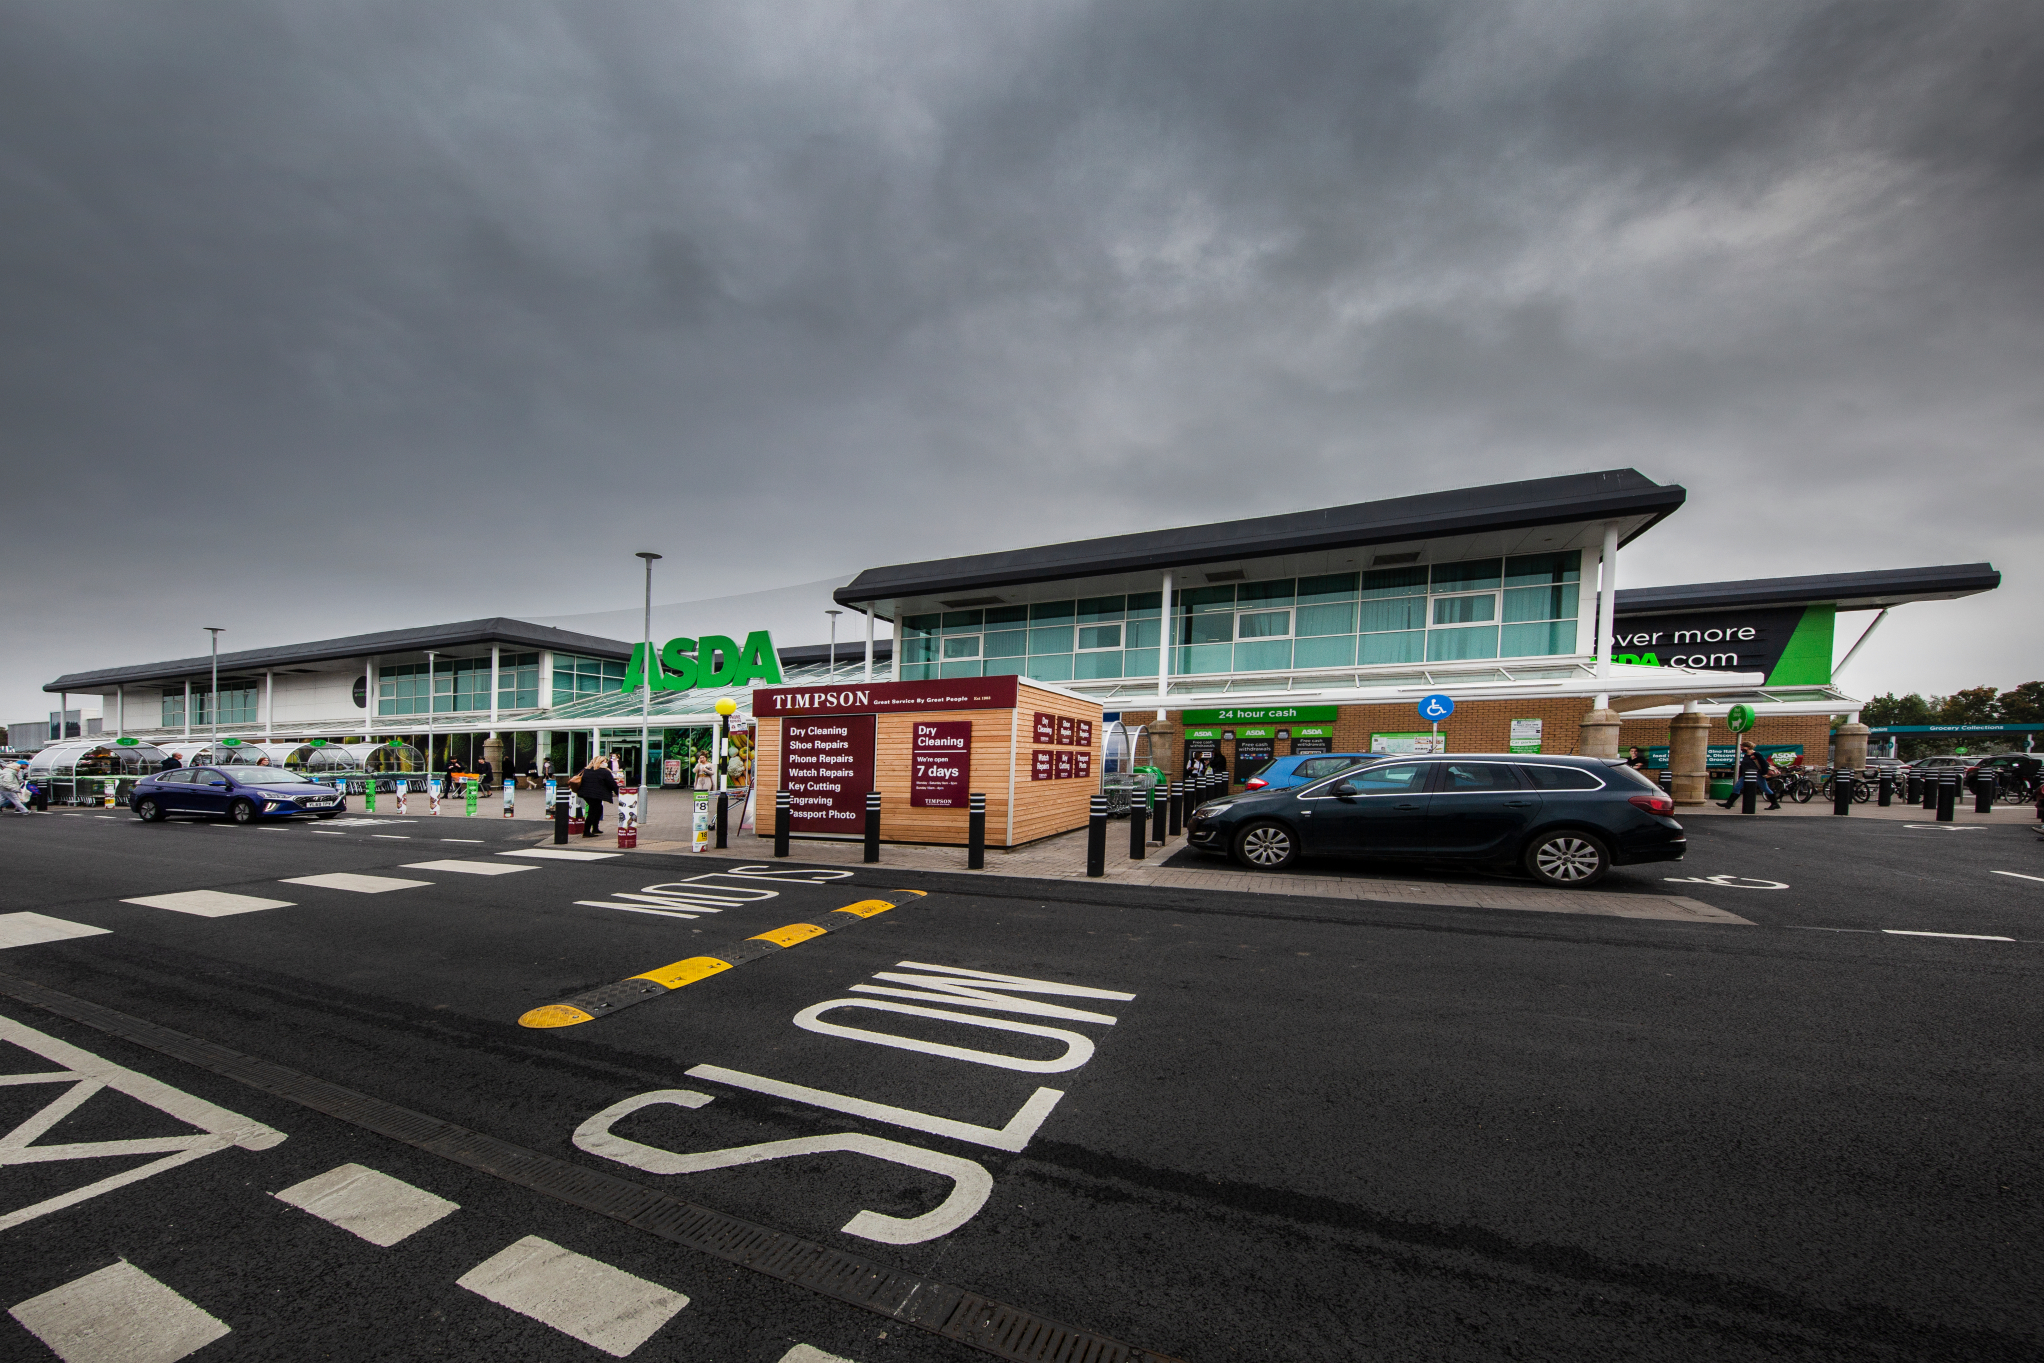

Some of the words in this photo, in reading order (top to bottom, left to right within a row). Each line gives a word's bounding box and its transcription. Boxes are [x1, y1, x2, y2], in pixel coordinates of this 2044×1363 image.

[1674, 626, 1756, 644] more
[621, 630, 784, 694] ASDA
[773, 690, 870, 709] TIMPSON
[1218, 710, 1233, 719] 24
[1237, 709, 1264, 718] hour
[1268, 708, 1297, 717] cash
[790, 727, 805, 737] Dry
[808, 726, 848, 736] Cleaning
[918, 726, 937, 736] Dry
[790, 741, 812, 749] Shoe
[814, 740, 848, 750] Repairs
[918, 737, 964, 747] Cleaning
[789, 754, 817, 763] Phone
[819, 754, 854, 764] Repairs
[789, 768, 817, 777] Watch
[820, 768, 854, 778] Repairs
[917, 766, 925, 777] 7
[928, 765, 959, 779] days
[788, 782, 805, 792] Key
[807, 782, 841, 792] Cutting
[790, 796, 832, 806] Engraving
[829, 810, 856, 819] Photo
[572, 865, 854, 918] SLOW
[572, 960, 1136, 1245] SLOW
